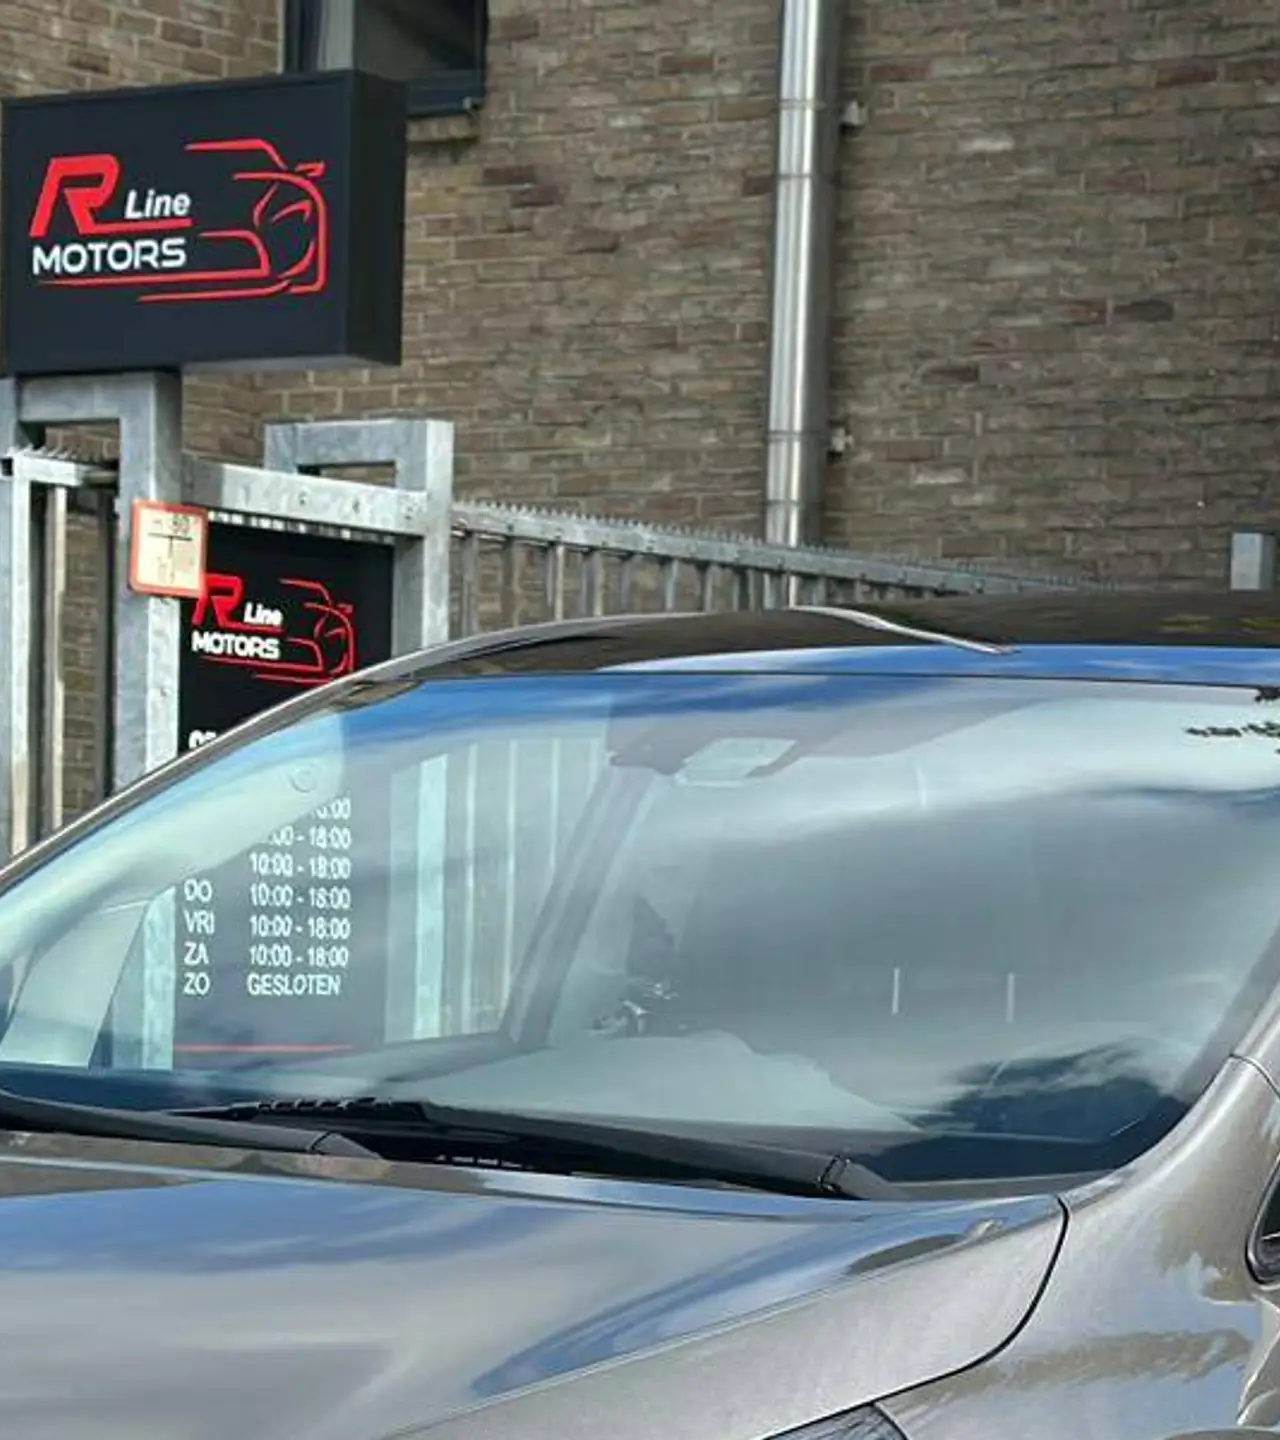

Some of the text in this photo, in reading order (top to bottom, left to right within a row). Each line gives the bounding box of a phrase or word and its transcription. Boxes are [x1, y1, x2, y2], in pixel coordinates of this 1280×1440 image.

[28, 153, 192, 238] R Line
[31, 236, 187, 276] MOTORS
[191, 573, 284, 627] R Line
[191, 629, 280, 660] MOTORS
[309, 825, 352, 849] 18:00
[250, 852, 294, 878] 10:00
[309, 854, 351, 880] 18:00
[183, 878, 213, 902] DO
[250, 882, 294, 907] 10:00
[308, 886, 352, 910] 18:00
[182, 907, 216, 935] VRI
[249, 914, 293, 938] 10:00
[307, 916, 351, 940] 18:00
[183, 941, 210, 965] ZA
[249, 943, 293, 968] 10:00
[307, 945, 350, 968] 18:00
[182, 972, 342, 996] ZO GESLOTEN
